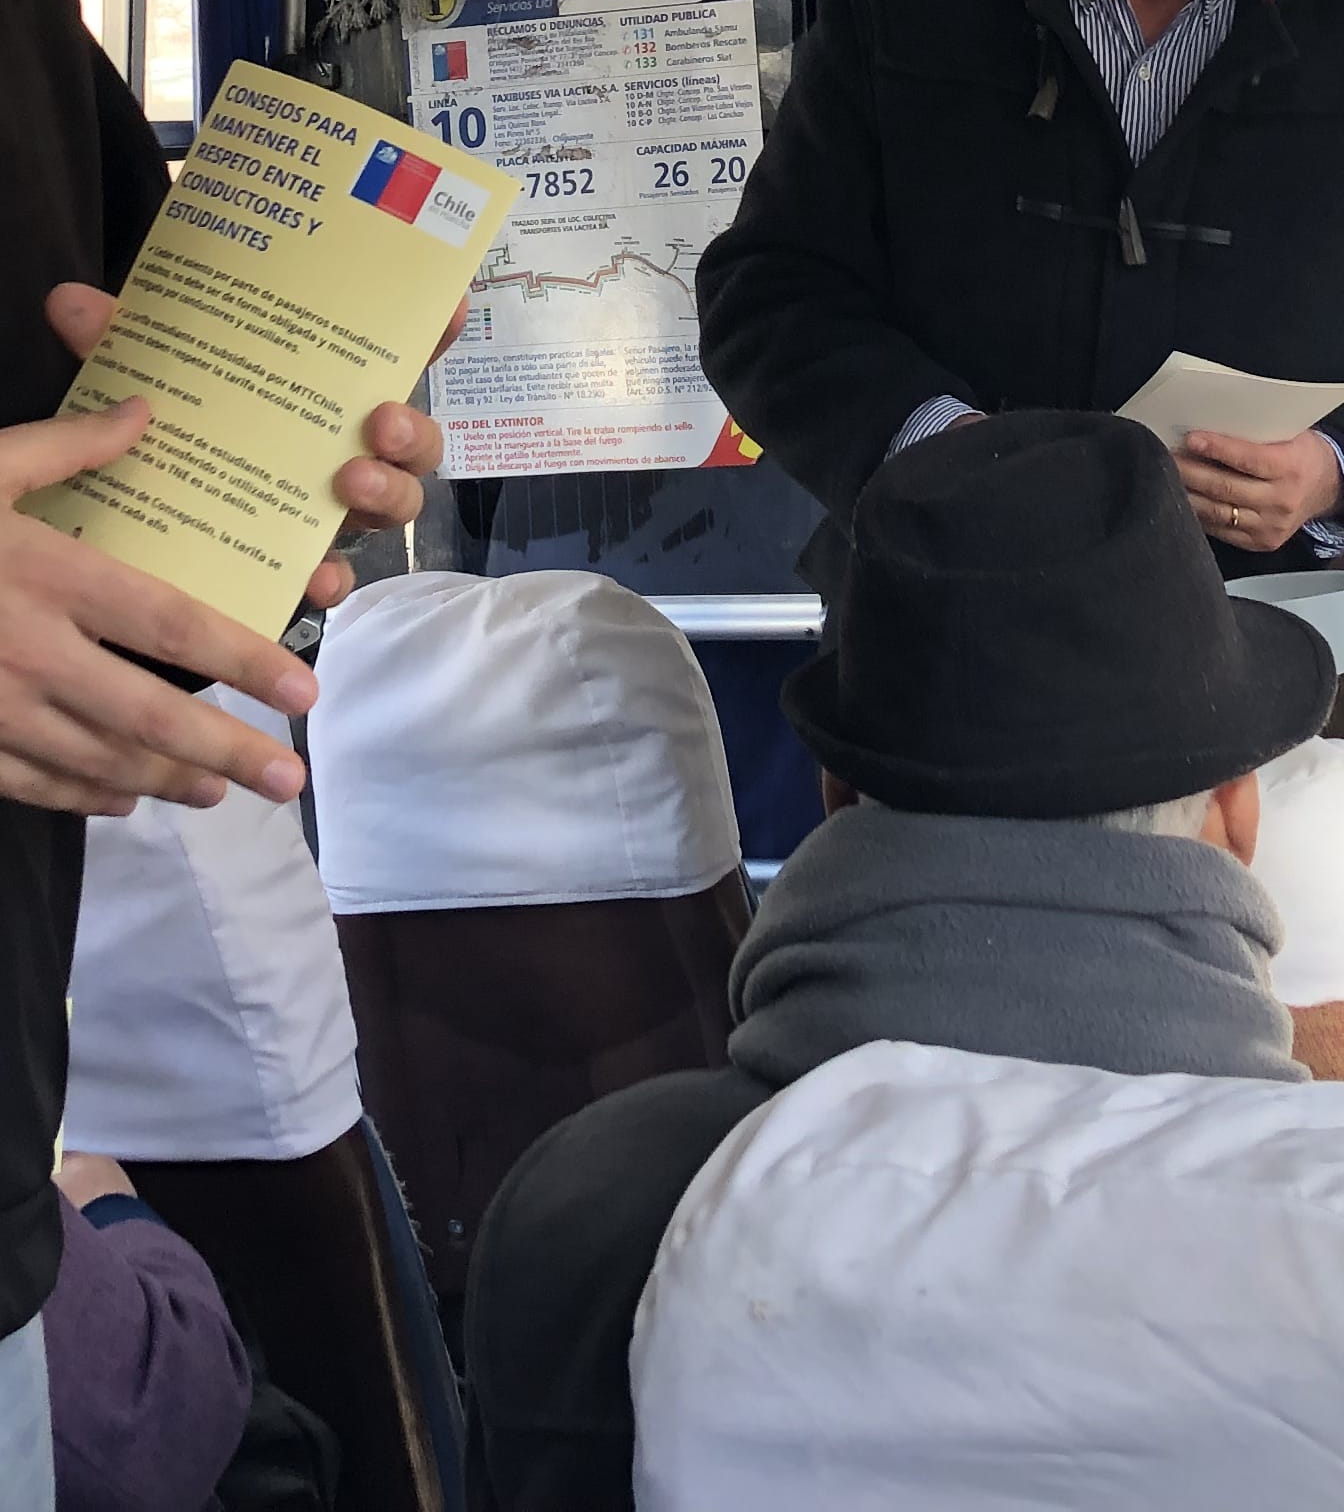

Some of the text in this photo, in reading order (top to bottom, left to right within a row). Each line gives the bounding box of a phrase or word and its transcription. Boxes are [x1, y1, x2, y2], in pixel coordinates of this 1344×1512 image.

[487, 0, 533, 14] Servicios
[620, 8, 717, 26] UTILIDAD PUBLICA
[487, 22, 537, 37] RECLAMOS
[540, 22, 547, 32] O
[634, 28, 654, 40] 131
[634, 37, 747, 54] 132 Bomberos Rescate
[635, 56, 658, 69] 133
[666, 55, 714, 67] Carabineros
[624, 78, 679, 92] SERVICIOS
[492, 90, 542, 104] TAXIBUSES
[544, 88, 562, 99] VIA
[624, 91, 654, 100] 10 D-M
[428, 98, 458, 110] LINEA
[626, 100, 652, 109] 10 A-N
[225, 84, 358, 147] CONSEJOS PARA
[626, 110, 636, 118] 10
[430, 106, 487, 148] 10
[627, 119, 637, 127] 10
[639, 118, 653, 126] C-P
[209, 112, 322, 167] MANTENER EL
[636, 143, 698, 156] CAPACIDAD
[496, 156, 530, 168] PLACA
[194, 142, 326, 202] RESPETO ENTRE
[654, 160, 690, 188] 26
[710, 156, 746, 184] 20
[180, 170, 324, 236] CONDUCTORES Y
[432, 190, 476, 223] Chile
[164, 200, 273, 252] ESTUDIANTES
[178, 294, 236, 324] conductores
[234, 318, 246, 329] y
[212, 270, 401, 364] por parte de pasajeros estudiantes
[221, 292, 236, 304] de
[236, 297, 268, 319] forma
[269, 314, 318, 342] obligada
[316, 337, 328, 348] y
[327, 341, 368, 368] menos
[684, 344, 692, 352] la
[209, 344, 267, 377] subsidiada
[266, 372, 288, 387] por
[444, 368, 456, 376] NO
[458, 368, 480, 378] pagar
[660, 364, 702, 374] moderado
[519, 372, 563, 381] estudiantes
[672, 375, 706, 385] pasajero
[212, 365, 225, 378] la
[224, 371, 256, 393] tarifa
[256, 387, 299, 413] escolar
[298, 407, 328, 429] todo
[328, 423, 343, 436] el
[448, 416, 544, 430] USO DEL EXTINTOR
[499, 430, 532, 440] posición
[567, 426, 582, 436] Tire
[618, 423, 662, 435] rompiendo
[464, 443, 493, 452] Apunte
[504, 441, 545, 450] manguera
[584, 436, 597, 446] del
[156, 420, 310, 502] calidad de estudiante, dicho
[464, 454, 493, 463] Apriete
[504, 452, 530, 461] gatillo
[496, 461, 532, 471] descarga
[544, 458, 568, 470] fuego
[570, 458, 584, 466] con
[586, 456, 638, 466] movimientos
[158, 440, 218, 475] transferido
[228, 475, 280, 506] utilizado
[278, 500, 305, 520] por
[302, 514, 320, 529] un
[190, 476, 204, 489] es
[204, 483, 222, 498] un
[120, 505, 147, 522] cada
[136, 491, 283, 571] de Concepción, la tarifa se
